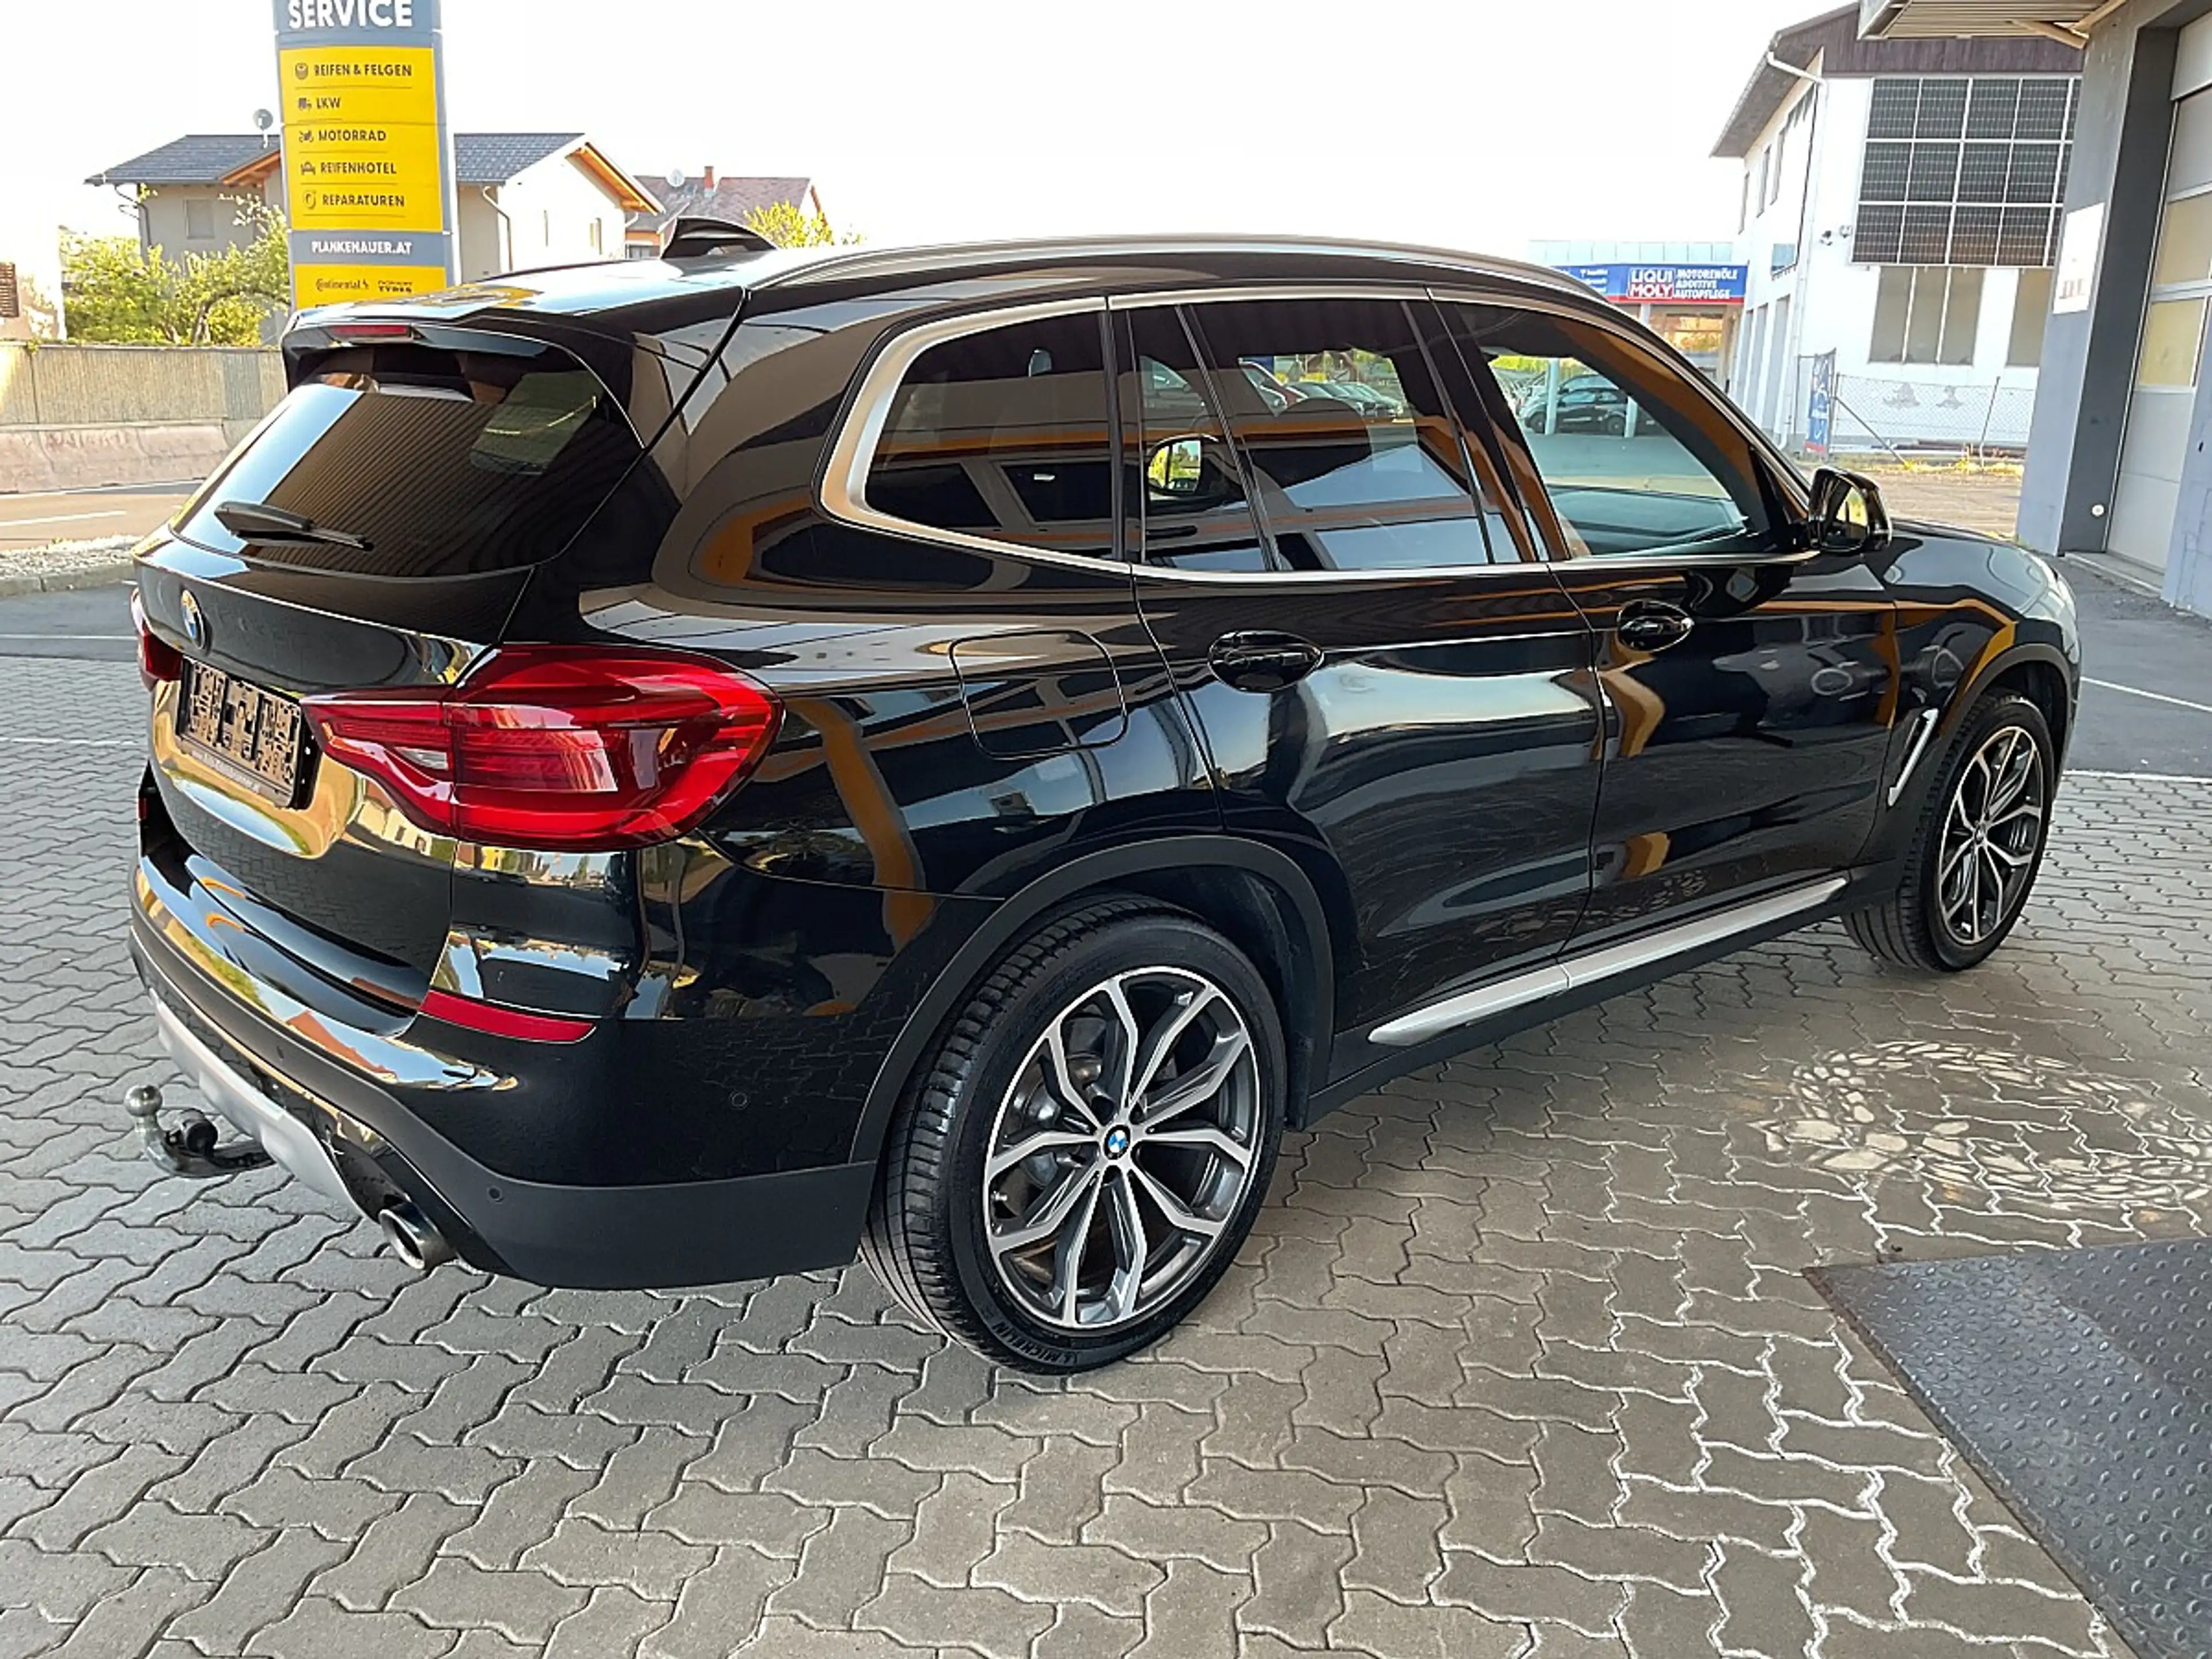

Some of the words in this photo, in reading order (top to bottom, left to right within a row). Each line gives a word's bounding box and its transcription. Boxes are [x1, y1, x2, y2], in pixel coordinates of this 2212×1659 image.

[289, 0, 413, 29] SERVICE
[314, 64, 351, 75] REIFEN
[354, 65, 361, 75] &
[365, 64, 412, 76] FELGEN
[316, 97, 341, 109] LKW
[317, 130, 387, 142] MOTORRAD
[320, 162, 397, 174] REIFENHOTEL
[323, 194, 404, 207] REPARATUREN
[312, 241, 412, 255] PLANKENAUER.AT
[1631, 269, 1673, 283] LIQUI
[1629, 284, 1674, 298] MOLY
[991, 1321, 1063, 1363] MICHELIN
